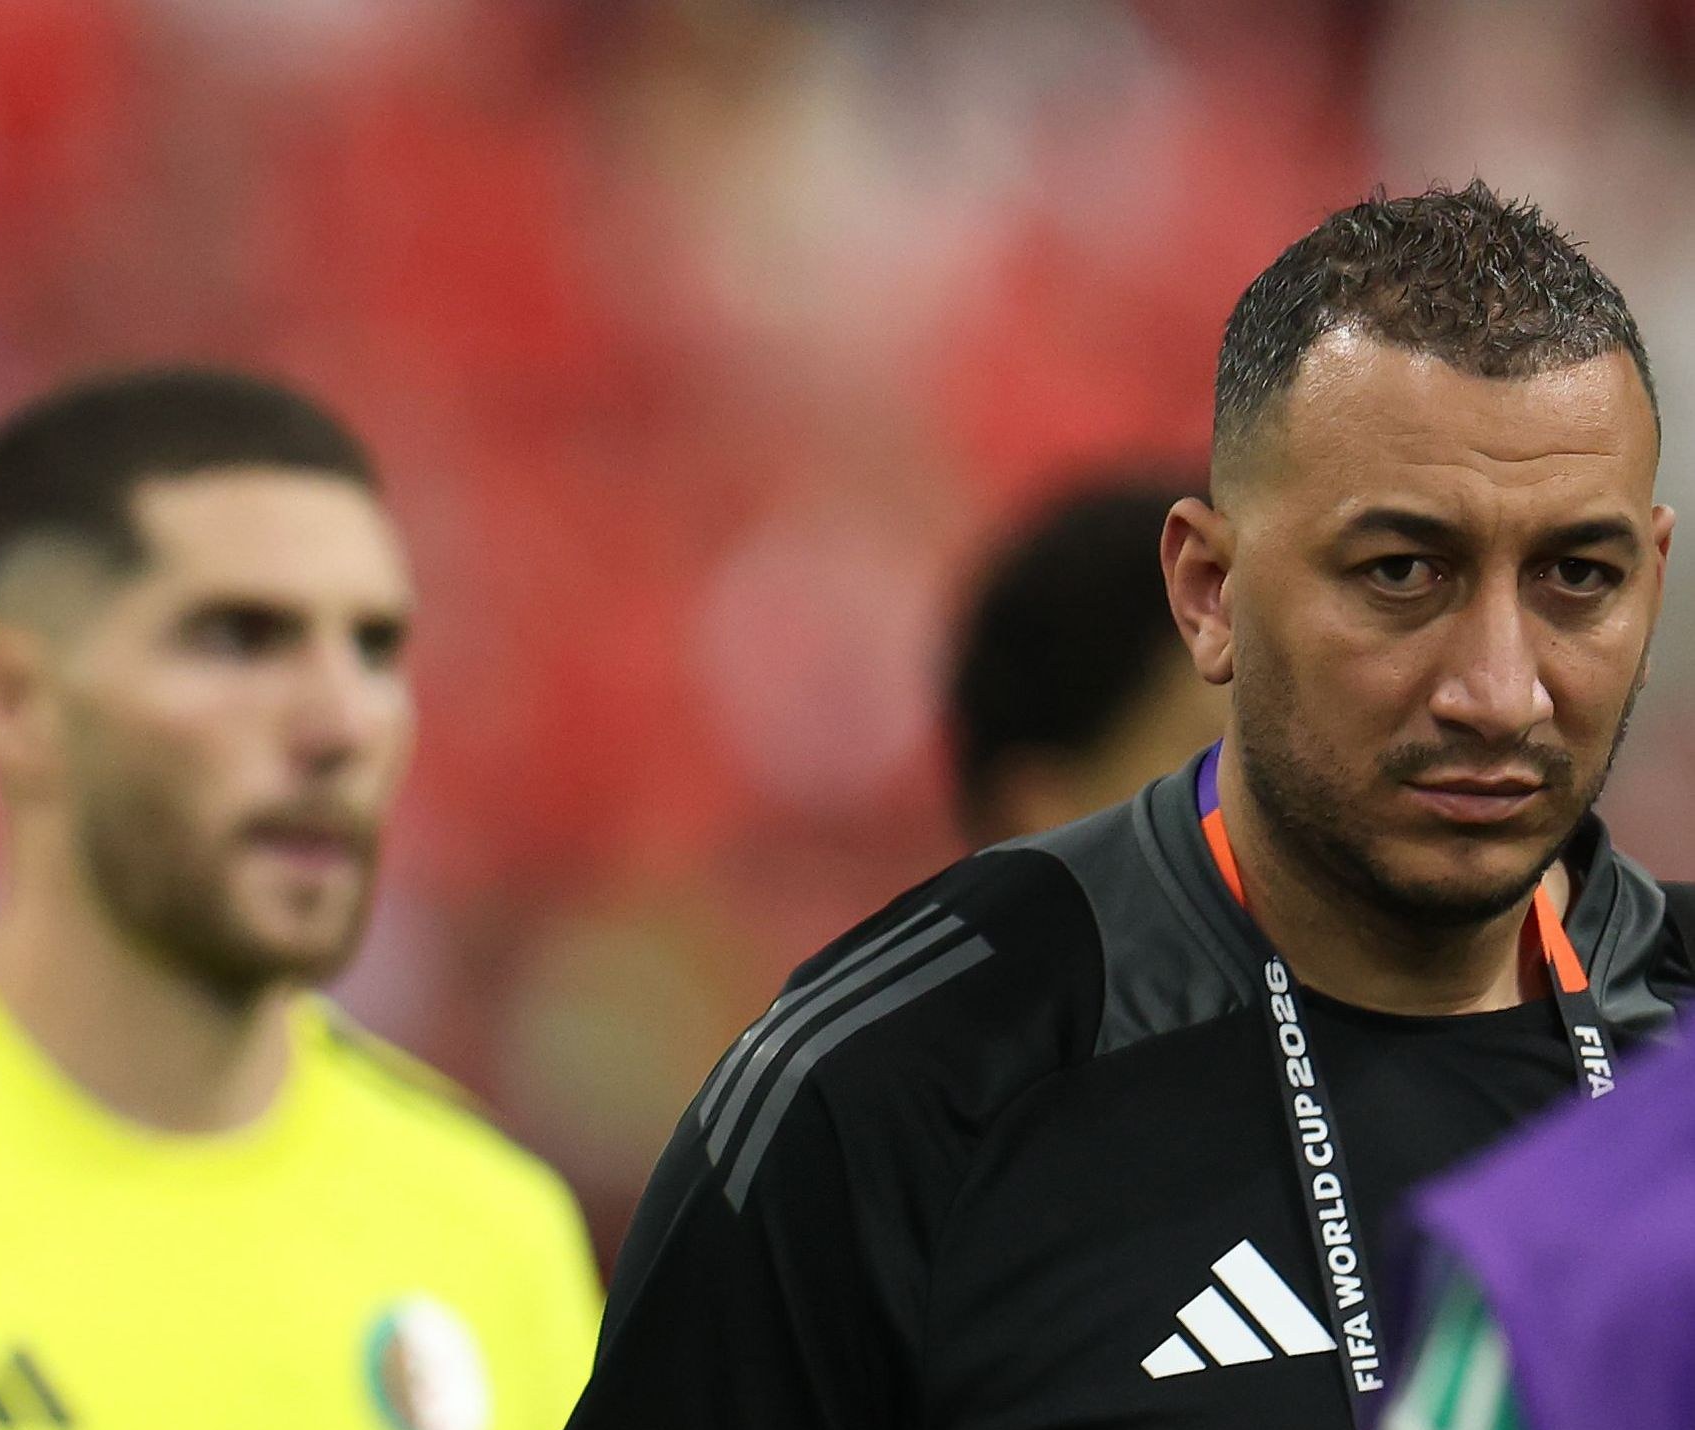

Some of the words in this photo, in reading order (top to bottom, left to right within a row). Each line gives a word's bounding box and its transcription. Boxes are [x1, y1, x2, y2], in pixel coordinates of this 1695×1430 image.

[1265, 958, 1315, 1088] 2026
[1574, 1026, 1615, 1099] FIFA
[1294, 1093, 1334, 1167] CUP
[1313, 1172, 1364, 1310] WORLD
[1343, 1311, 1384, 1392] FIFA
